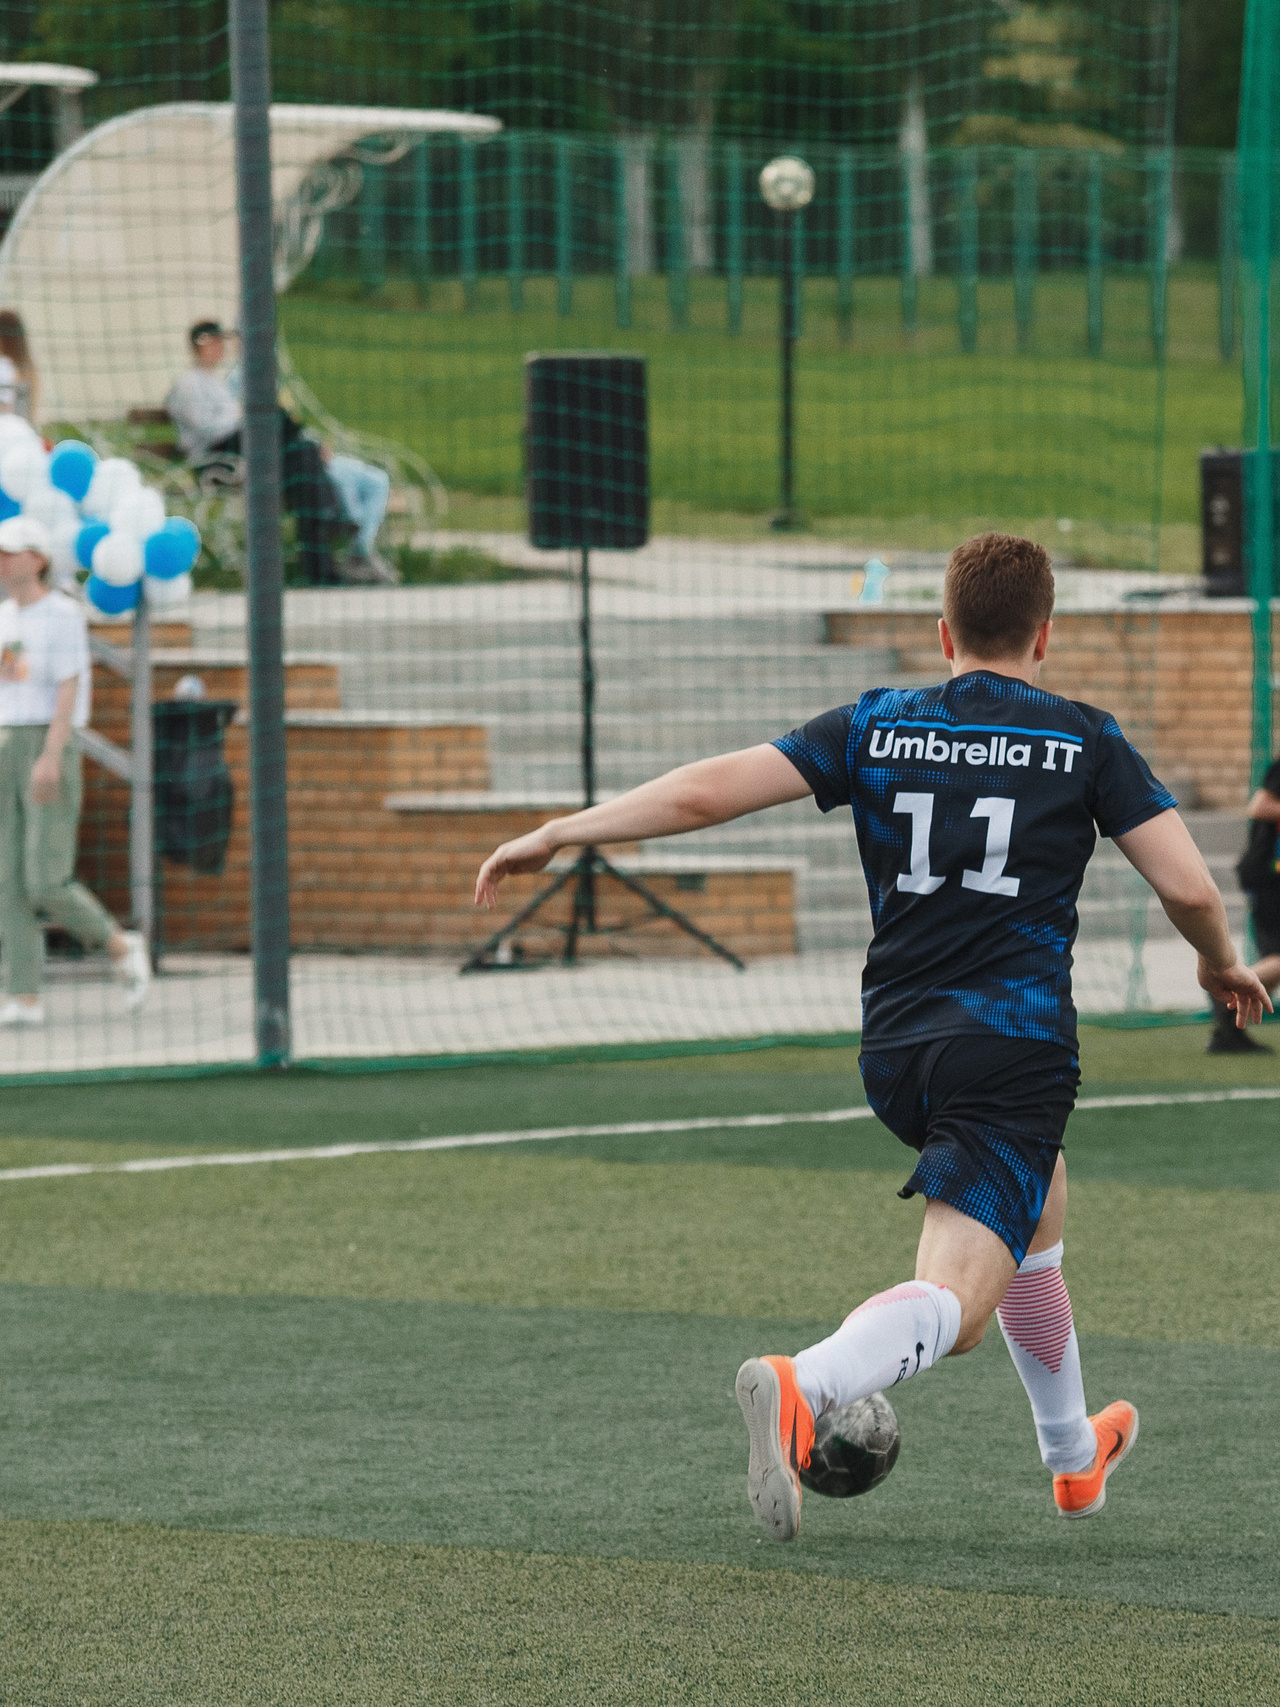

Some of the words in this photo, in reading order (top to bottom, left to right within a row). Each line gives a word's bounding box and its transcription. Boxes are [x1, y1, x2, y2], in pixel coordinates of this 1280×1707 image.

[868, 729, 1032, 767] Umbrella
[1042, 739, 1083, 773] IT
[892, 791, 1021, 898] 11
